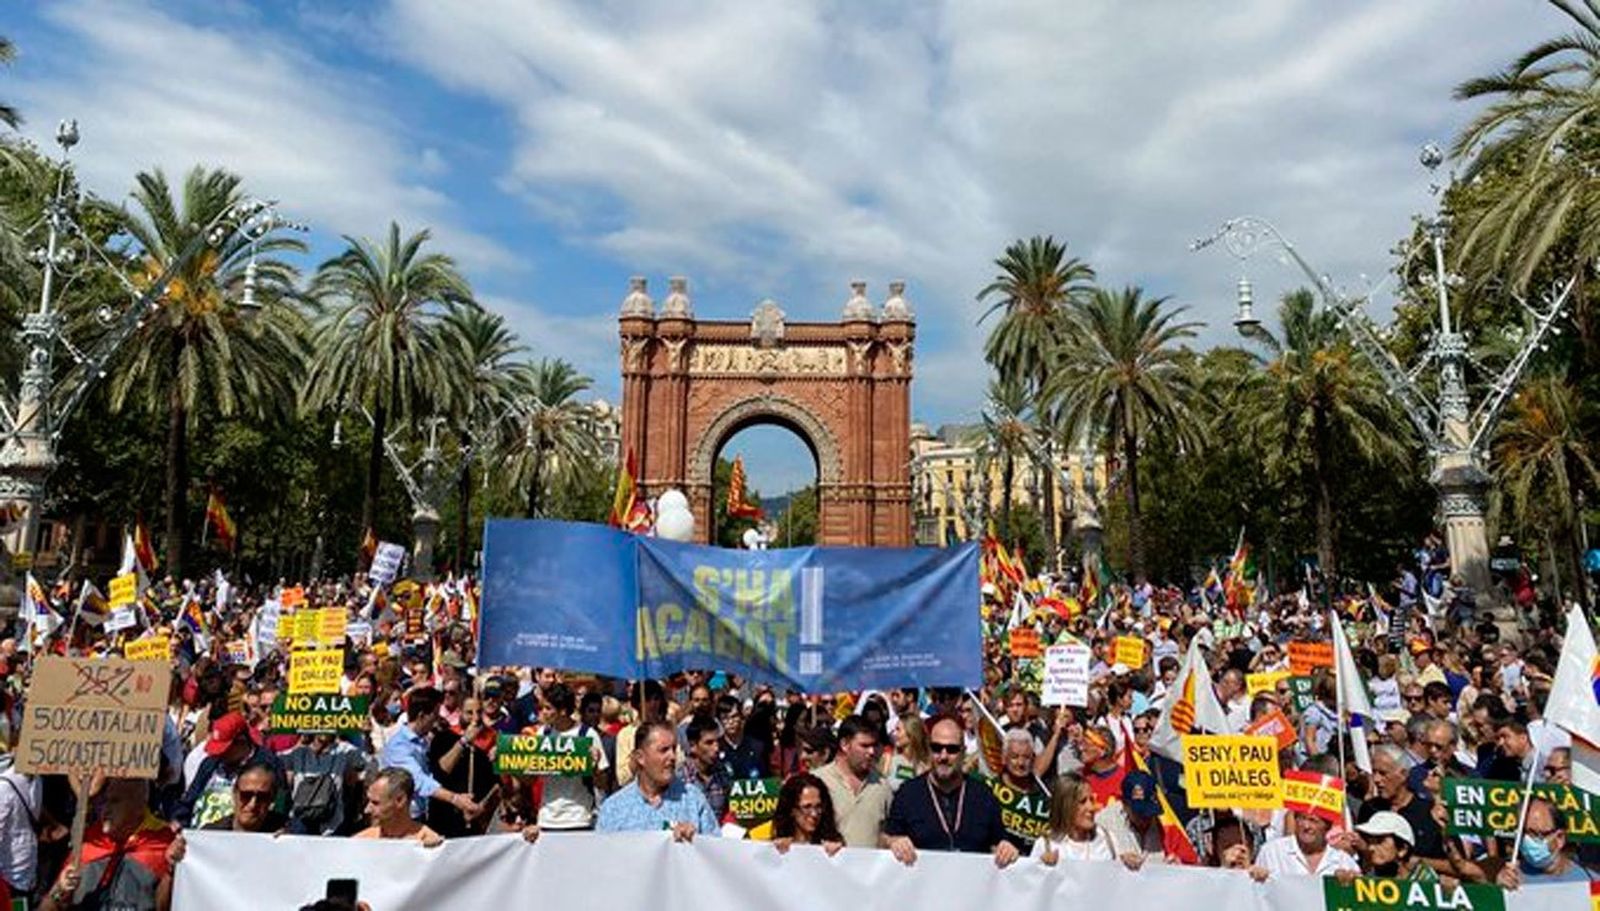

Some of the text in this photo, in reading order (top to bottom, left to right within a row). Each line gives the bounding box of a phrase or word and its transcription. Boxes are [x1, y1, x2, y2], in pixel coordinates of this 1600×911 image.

[285, 697, 352, 711] NO A LA
[271, 711, 364, 729] INMERSIÓN
[512, 736, 575, 752] NO A LA
[499, 752, 587, 772] INMERSIÓN
[1240, 746, 1273, 762] PAU
[730, 780, 767, 796] A LA
[1196, 772, 1202, 786] I
[729, 794, 778, 814] RSIÓN
[1016, 796, 1031, 814] A
[1036, 800, 1050, 818] L
[1455, 785, 1592, 811] EN CALÀ I
[1453, 810, 1483, 828] EN
[1355, 879, 1474, 910] NO A LA
